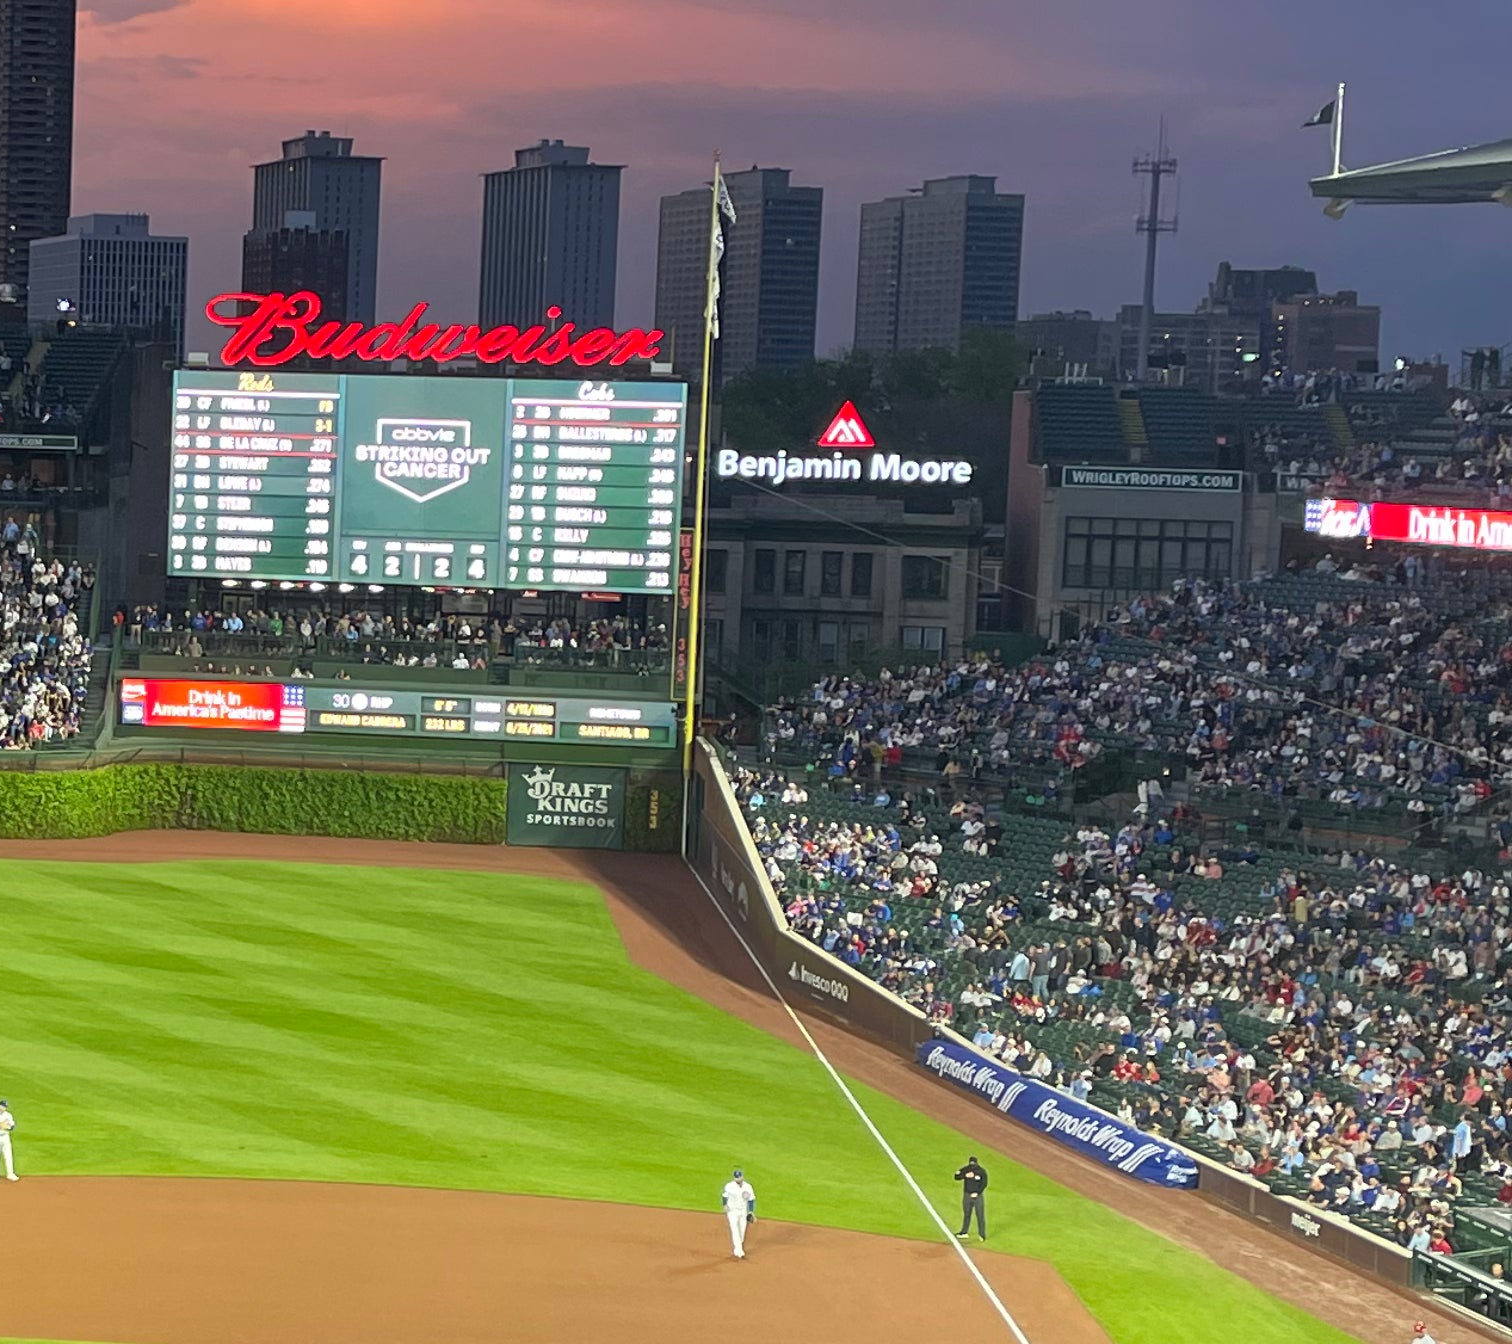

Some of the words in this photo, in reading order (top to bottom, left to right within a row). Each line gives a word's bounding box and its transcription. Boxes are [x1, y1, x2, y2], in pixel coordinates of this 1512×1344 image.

[205, 289, 665, 367] Budweiser
[238, 372, 275, 392] Reds
[235, 437, 249, 450] LA
[355, 444, 449, 464] STRIKING
[450, 447, 491, 465] OUT
[383, 462, 461, 479] CANCER
[718, 449, 861, 485] Benjamin
[870, 453, 973, 482] Moore
[1072, 470, 1234, 489] WRIGLEYROOFTOPS.COM
[1409, 509, 1456, 541] Drink
[351, 554, 368, 575] 4
[385, 556, 400, 576] 2
[434, 557, 450, 578] 2
[468, 559, 485, 579] 4
[189, 689, 226, 705] Drink
[152, 704, 218, 719] America's
[220, 706, 275, 722] Pastime
[527, 781, 613, 799] DRAFT
[537, 795, 608, 814] KINGS
[526, 814, 616, 828] SPORTSBOOK
[801, 964, 830, 993] Invesco
[926, 1046, 977, 1087] Reynolds
[972, 1066, 1005, 1106] Wrap
[1034, 1099, 1095, 1143] Reynolds
[1091, 1125, 1134, 1161] Wrap
[1291, 1212, 1321, 1237] meijer
